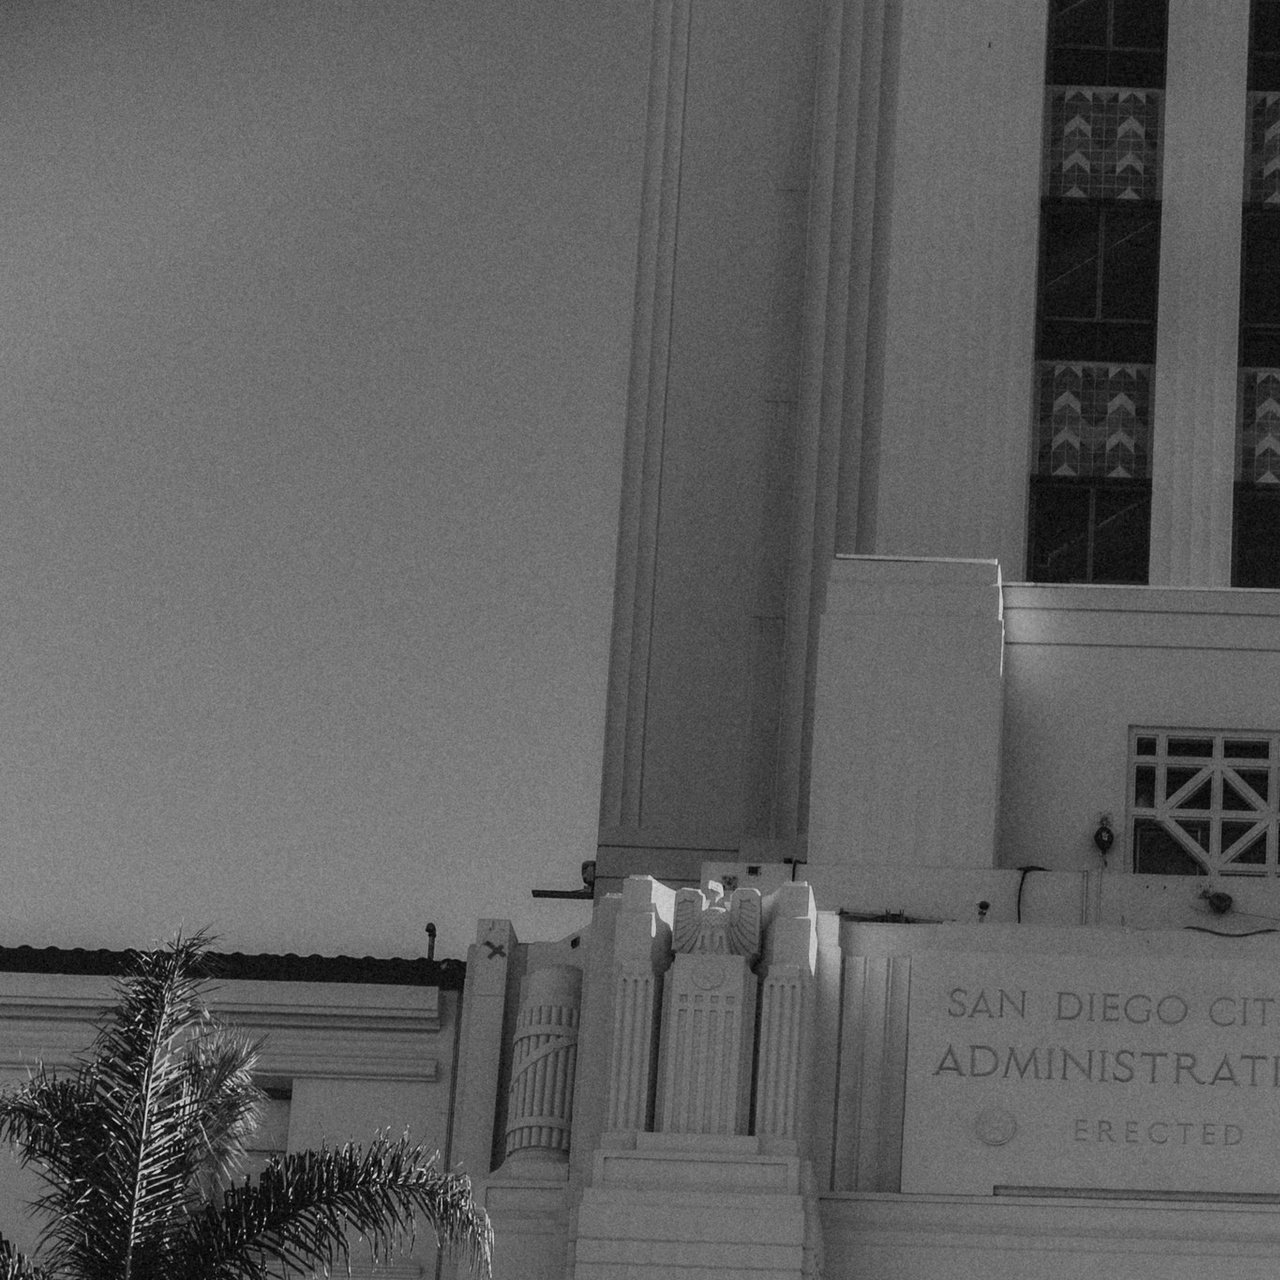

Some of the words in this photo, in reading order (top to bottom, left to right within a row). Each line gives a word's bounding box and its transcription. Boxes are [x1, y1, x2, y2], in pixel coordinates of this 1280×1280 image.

[947, 987, 1027, 1019] SAN
[1055, 991, 1189, 1025] DIEGO
[1073, 1118, 1244, 1146] ERECTED
